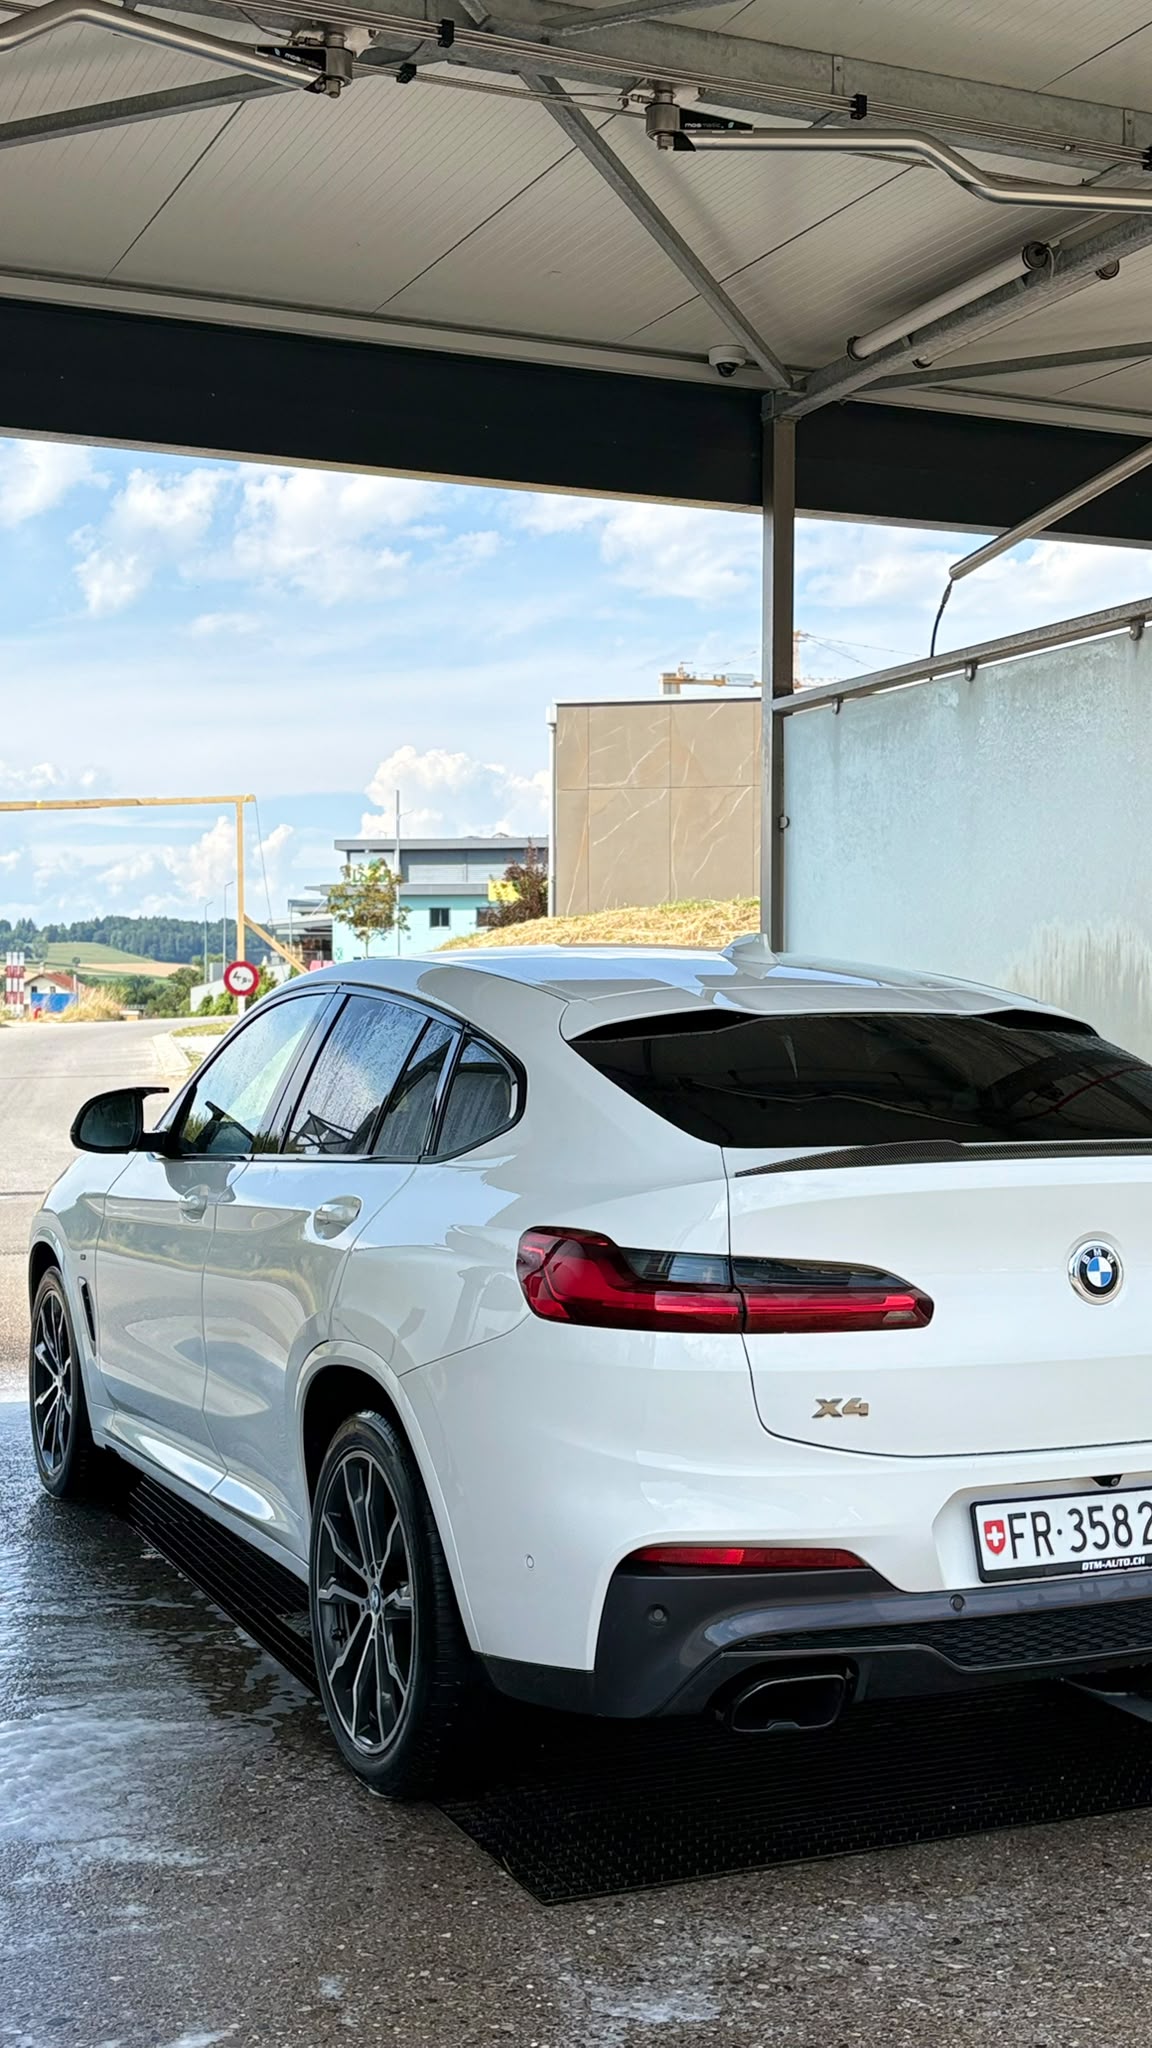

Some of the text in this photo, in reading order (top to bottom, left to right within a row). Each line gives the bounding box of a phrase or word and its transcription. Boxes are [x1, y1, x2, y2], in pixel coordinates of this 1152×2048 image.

[1081, 1247, 1116, 1265] BMW
[811, 1397, 869, 1418] X4
[1081, 1556, 1145, 1571] DTM-AUTO.CH
